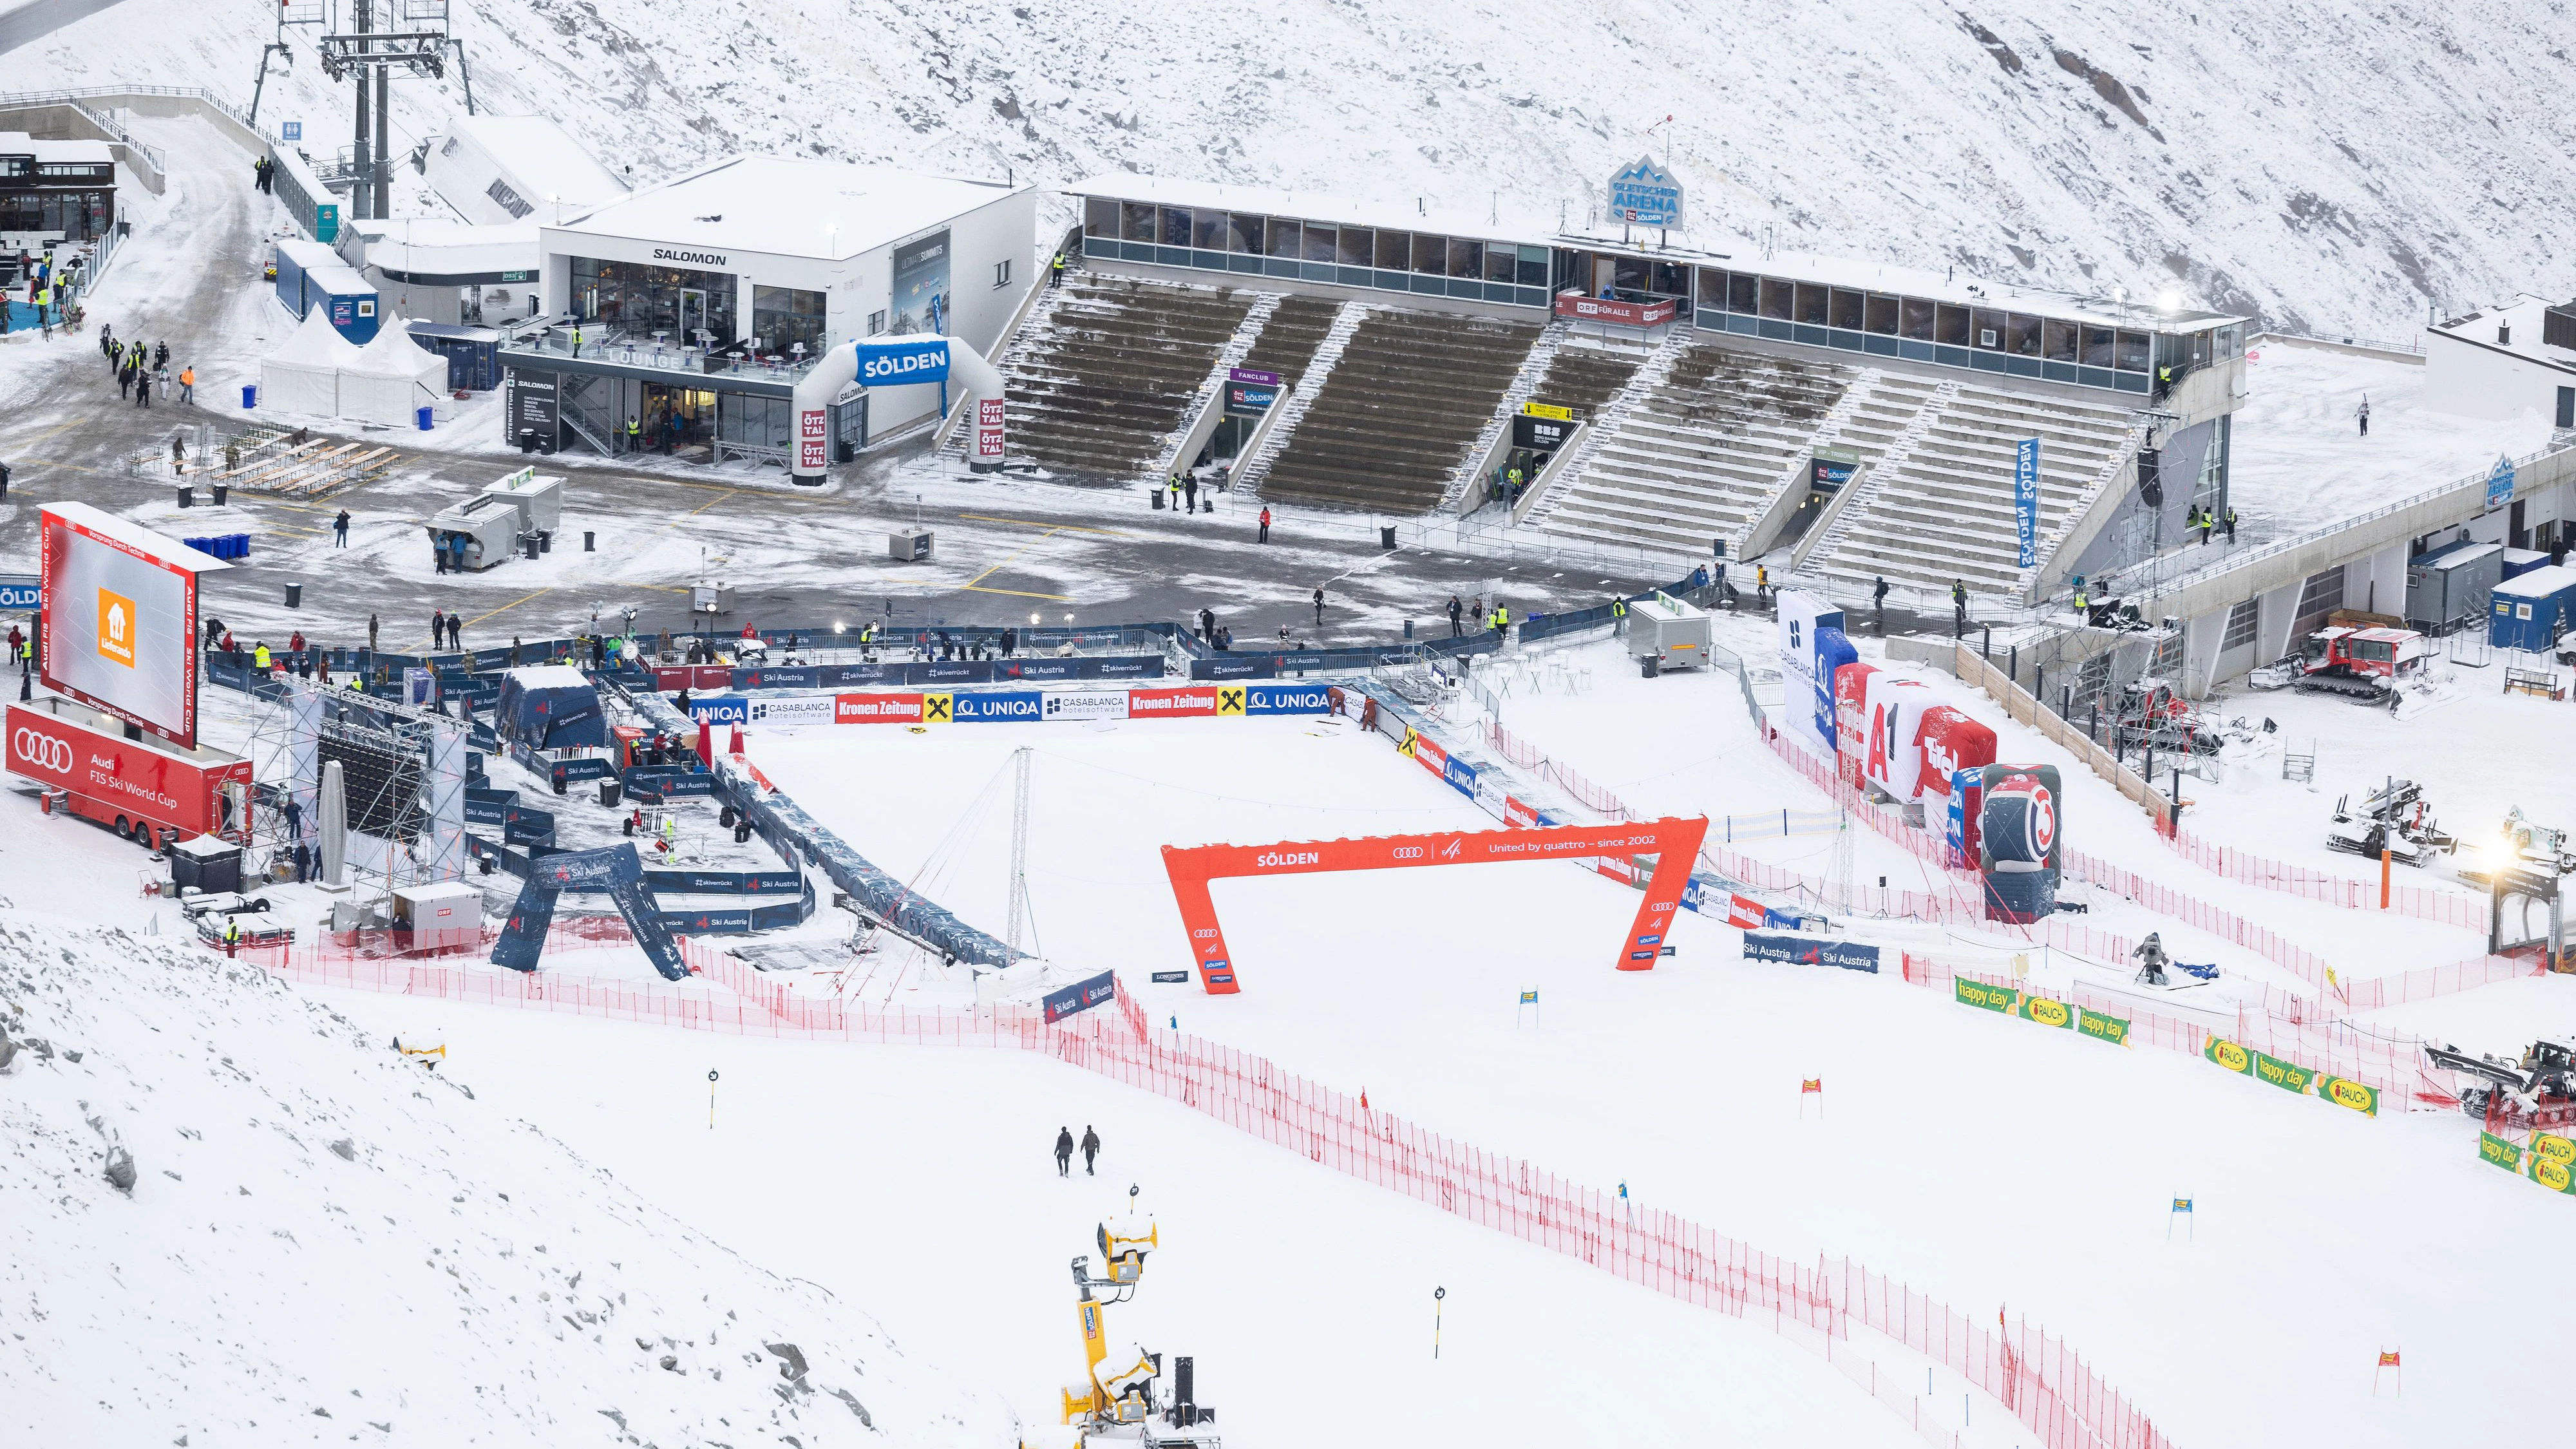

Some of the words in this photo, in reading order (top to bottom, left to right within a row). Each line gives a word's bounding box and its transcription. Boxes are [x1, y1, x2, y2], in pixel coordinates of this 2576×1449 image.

[1613, 182, 1678, 198] GLETSCHER
[1613, 192, 1678, 213] ARENA
[654, 249, 726, 266] SALOMON
[609, 350, 680, 369] LOUNGE
[865, 350, 947, 379] SÖLDEN
[1238, 372, 1269, 381] FANCLUB
[518, 381, 554, 391] SALOMON
[840, 386, 868, 402] SALOMON
[1245, 393, 1273, 402] SÖLDEN
[981, 403, 1002, 414] ÖTZ
[804, 413, 824, 426] ÖTZ
[981, 415, 1002, 423] TAL
[804, 426, 824, 435] TAL
[981, 433, 1002, 444] ÖTZ
[804, 444, 824, 456] ÖTZ
[981, 444, 1002, 453] TAL
[1831, 451, 1855, 460] TRIBÜNE
[804, 457, 824, 465] TAL
[2487, 479, 2514, 497] ARENA
[89, 529, 113, 547] Vorsprung
[113, 538, 128, 551] Durch
[128, 545, 146, 559] Technik
[101, 638, 131, 659] Lieferando
[477, 656, 504, 666] #skiverrückt
[1101, 664, 1142, 673] #skiverrückt
[1780, 649, 1815, 679] CASABLANCA
[764, 674, 777, 682] Ski
[841, 671, 883, 681] #skiverrückt
[927, 669, 969, 678] #skiverrückt
[1025, 666, 1037, 674] Ski
[1213, 665, 1254, 675] #skiverrückt
[769, 703, 831, 713] CASABLANCA
[839, 701, 878, 716] Kronen
[878, 700, 921, 717] Zeitung
[983, 701, 1039, 716] UNIQA
[1063, 697, 1124, 707] CASABLANCA
[1132, 695, 1171, 710] Kronen
[1172, 694, 1215, 710] Zeitung
[1275, 694, 1331, 708] UNIQA
[1345, 697, 1365, 710] CASABL
[87, 697, 111, 715] Vorsprung
[111, 707, 126, 719] Durch
[126, 713, 144, 728] Technik
[688, 706, 744, 722] UNIQA
[1063, 706, 1124, 714] hotelsoftware
[558, 711, 588, 726] #skiverrückt
[478, 735, 494, 744] Austria
[1868, 703, 1899, 783] A1
[91, 753, 115, 770] Audi
[1416, 741, 1430, 760] Kronen
[1429, 750, 1445, 773] Zeitung
[1924, 735, 1959, 783] Tirol
[1454, 768, 1475, 794] UNIQA
[90, 770, 106, 785] FIS
[108, 775, 123, 791] Ski
[125, 781, 155, 800] World
[158, 792, 177, 810] Cup
[477, 810, 501, 819] Austria
[1489, 842, 1526, 853] United
[1528, 841, 1542, 852] by
[1544, 840, 1586, 852] quattro
[1597, 838, 1625, 848] since
[1627, 835, 1656, 846] 2002
[1257, 852, 1318, 867] SÖLDEN
[572, 867, 585, 878] Ski
[585, 865, 611, 876] Austria
[695, 878, 733, 887] #skiverrückt
[1731, 900, 1747, 918] Kronen
[620, 898, 649, 943] #skiverrückt
[1640, 936, 1659, 944] SÖLDEN
[1744, 943, 1757, 954] Ski
[1759, 945, 1791, 959] Austria
[1823, 952, 1837, 963] Ski
[1839, 954, 1871, 967] Austria
[1097, 983, 1113, 998] Austria
[1958, 981, 1988, 1006] happy
[1989, 990, 2008, 1010] day
[1055, 1003, 1063, 1015] Ski
[1063, 998, 1076, 1013] Austria
[2039, 1005, 2063, 1021] RAUCH
[2081, 1012, 2106, 1036] happy
[2107, 1020, 2123, 1041] day
[2224, 1048, 2244, 1066] RAUCH
[2260, 1056, 2286, 1084] happy
[2287, 1068, 2306, 1090] day
[2341, 1086, 2367, 1105] RAUCH
[2482, 1135, 2503, 1162] happy
[2503, 1145, 2517, 1168] day
[2545, 1142, 2571, 1159] RAUCH
[2544, 1166, 2565, 1185] RAUCH
[1084, 1307, 1095, 1330] SÖLDEN
